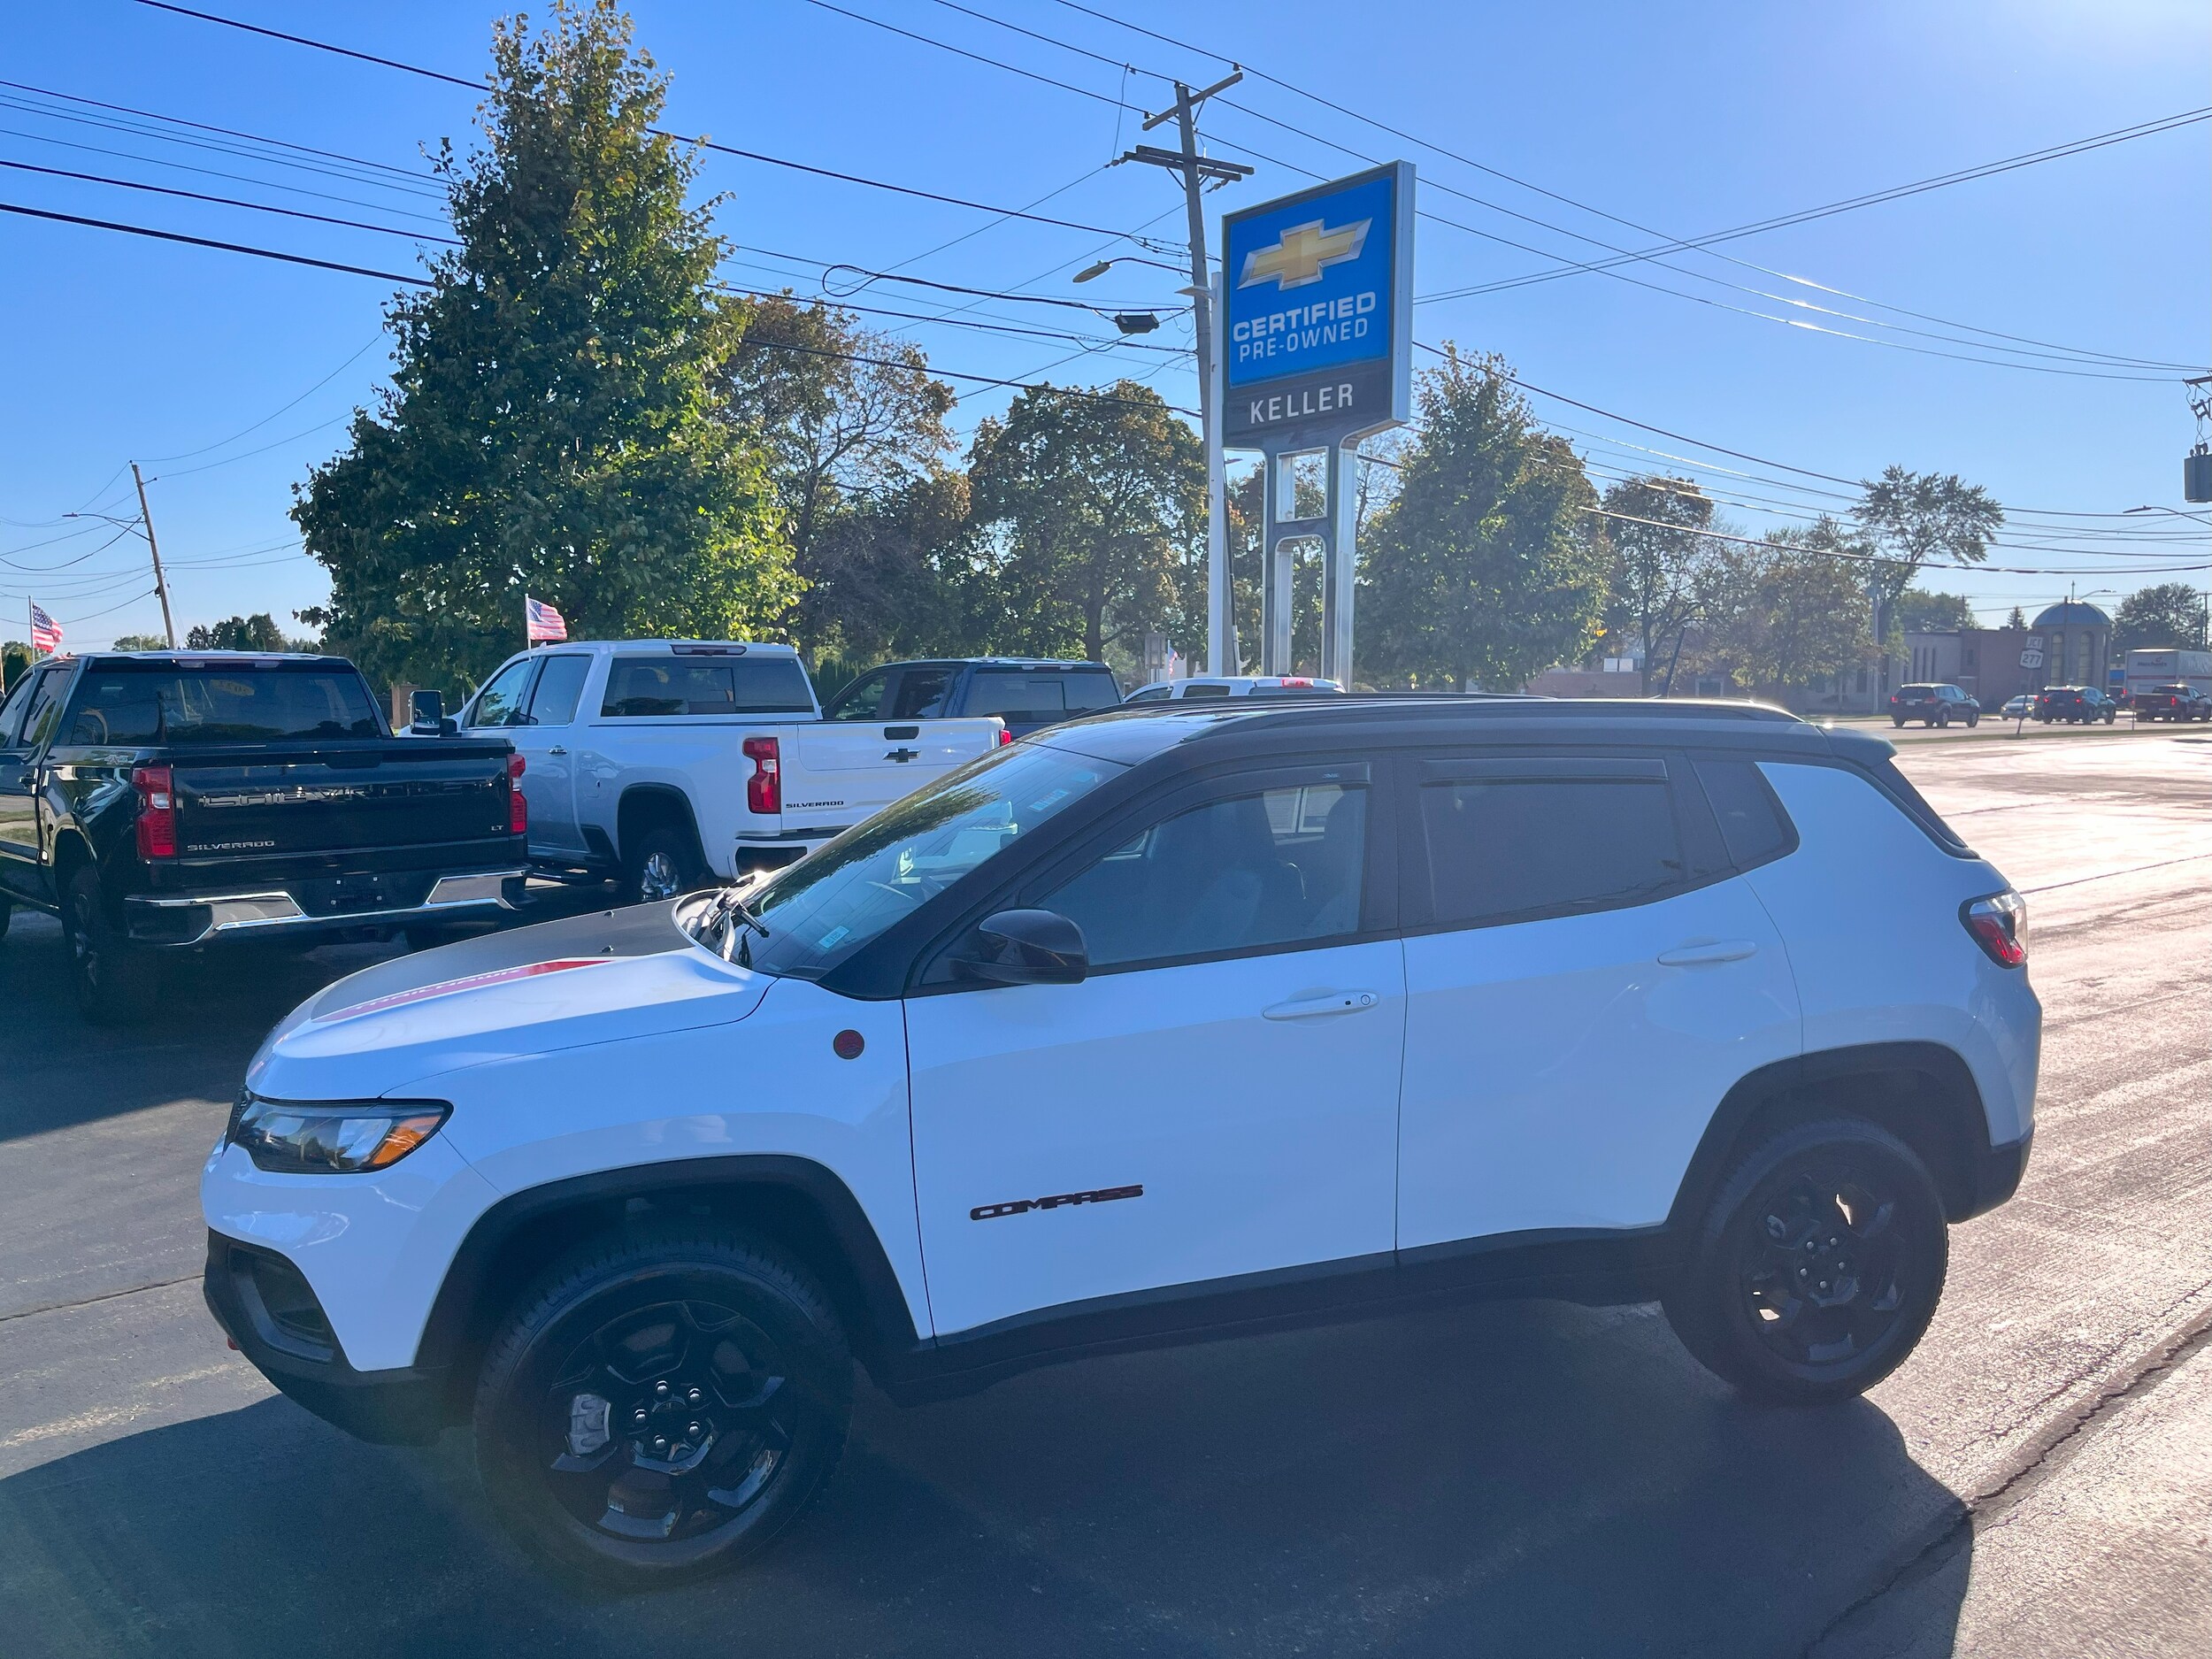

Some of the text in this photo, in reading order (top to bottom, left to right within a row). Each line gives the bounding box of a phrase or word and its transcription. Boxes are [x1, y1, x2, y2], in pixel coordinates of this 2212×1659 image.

[1233, 292, 1376, 342] CERTIFIED
[1240, 318, 1368, 363] PRE-OWNED
[1250, 383, 1353, 425] KELLER
[2023, 654, 2041, 664] 277
[187, 841, 275, 851] SILVERADO
[970, 1184, 1144, 1221] COMPASS
